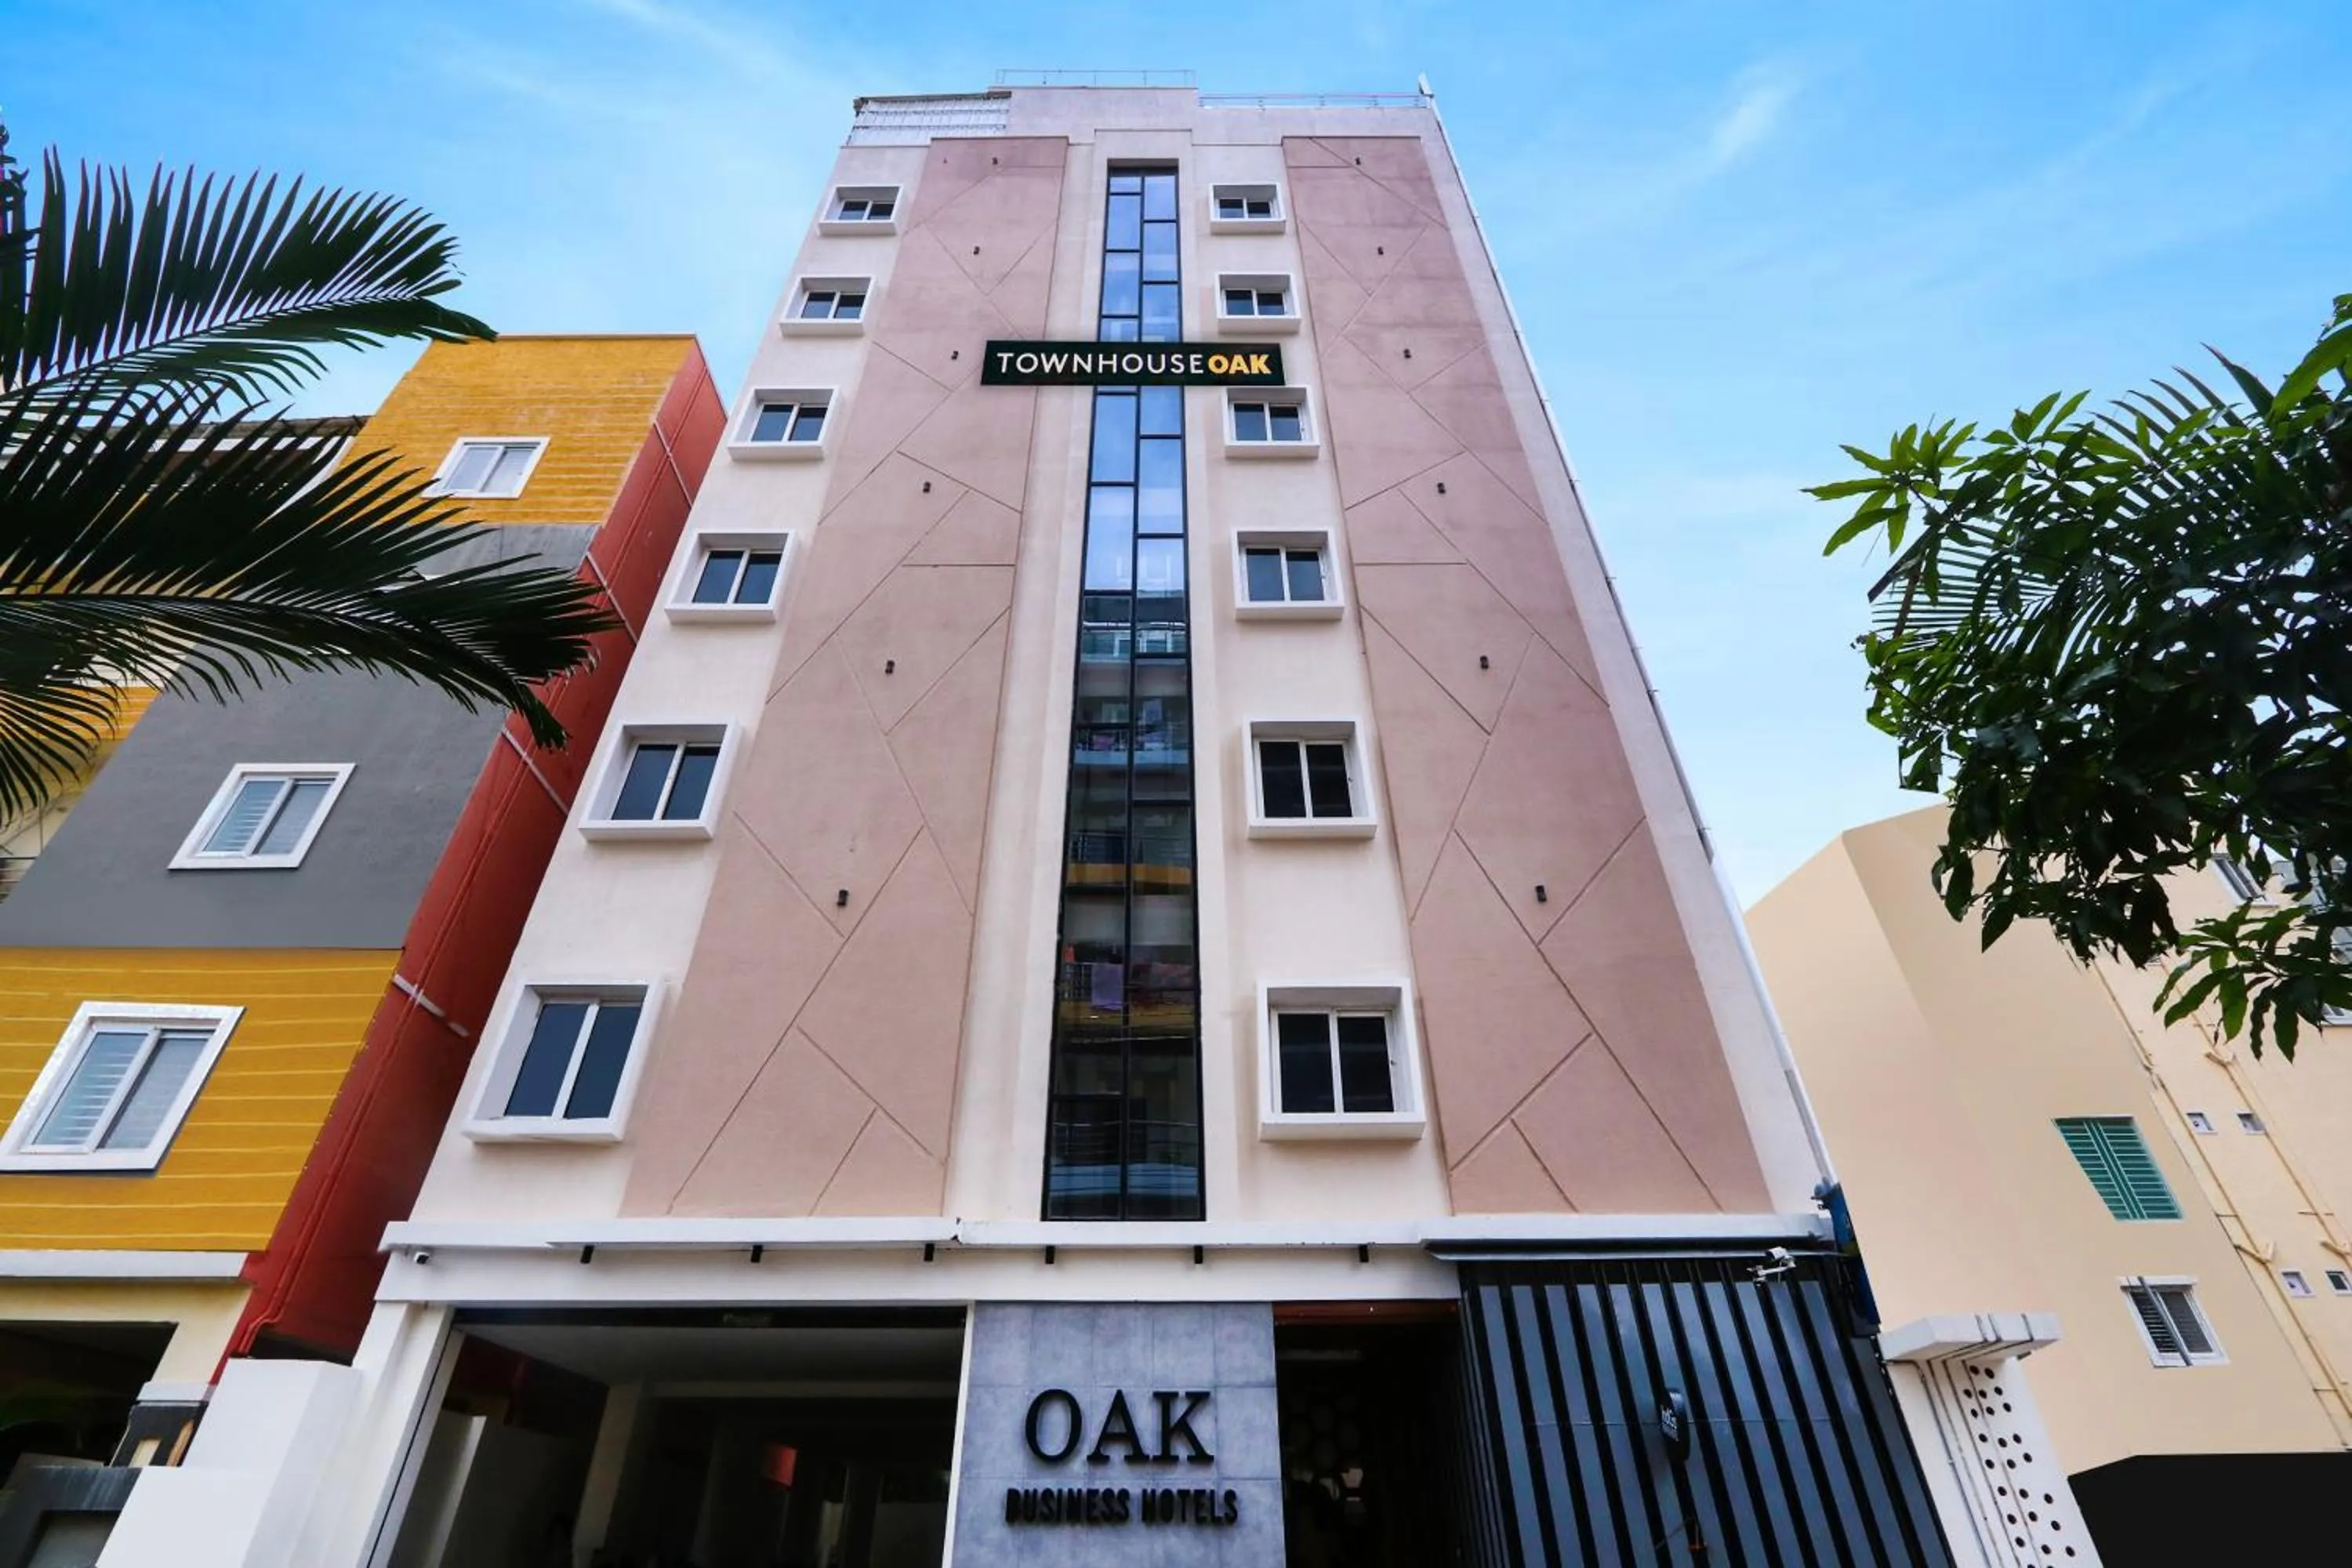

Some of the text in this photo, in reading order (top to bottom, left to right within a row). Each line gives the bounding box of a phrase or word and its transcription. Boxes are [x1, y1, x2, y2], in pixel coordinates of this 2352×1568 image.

[1025, 1388, 1214, 1464] OAK
[1005, 1487, 1239, 1524] BUSINESS HOTELS
